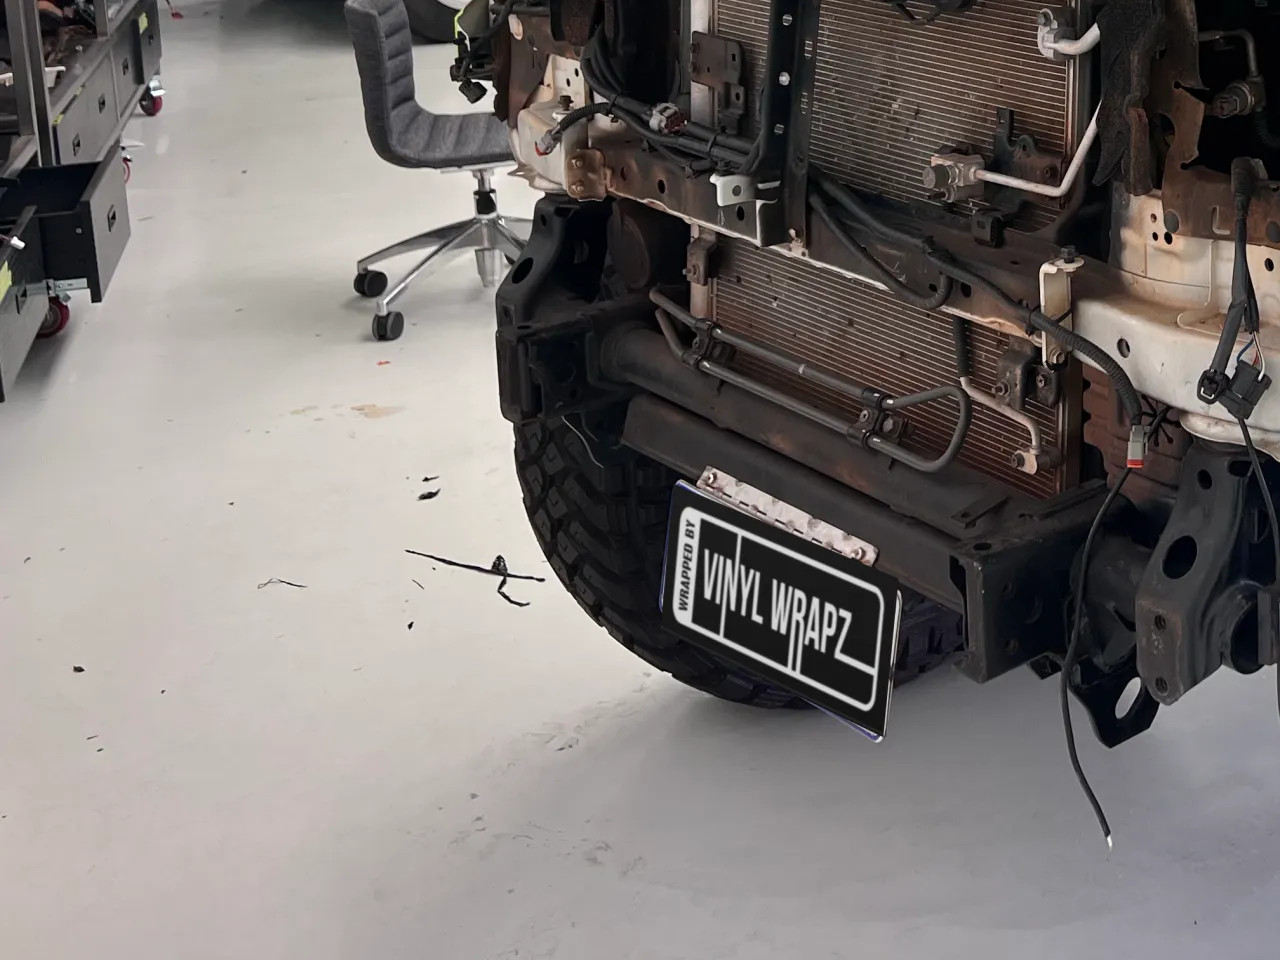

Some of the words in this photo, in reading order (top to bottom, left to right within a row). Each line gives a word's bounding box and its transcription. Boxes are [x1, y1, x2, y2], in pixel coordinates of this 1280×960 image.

[685, 519, 696, 540] BY
[678, 543, 694, 612] WRAPPED
[703, 548, 764, 624] VINYL
[770, 578, 875, 674] WRAPZ
